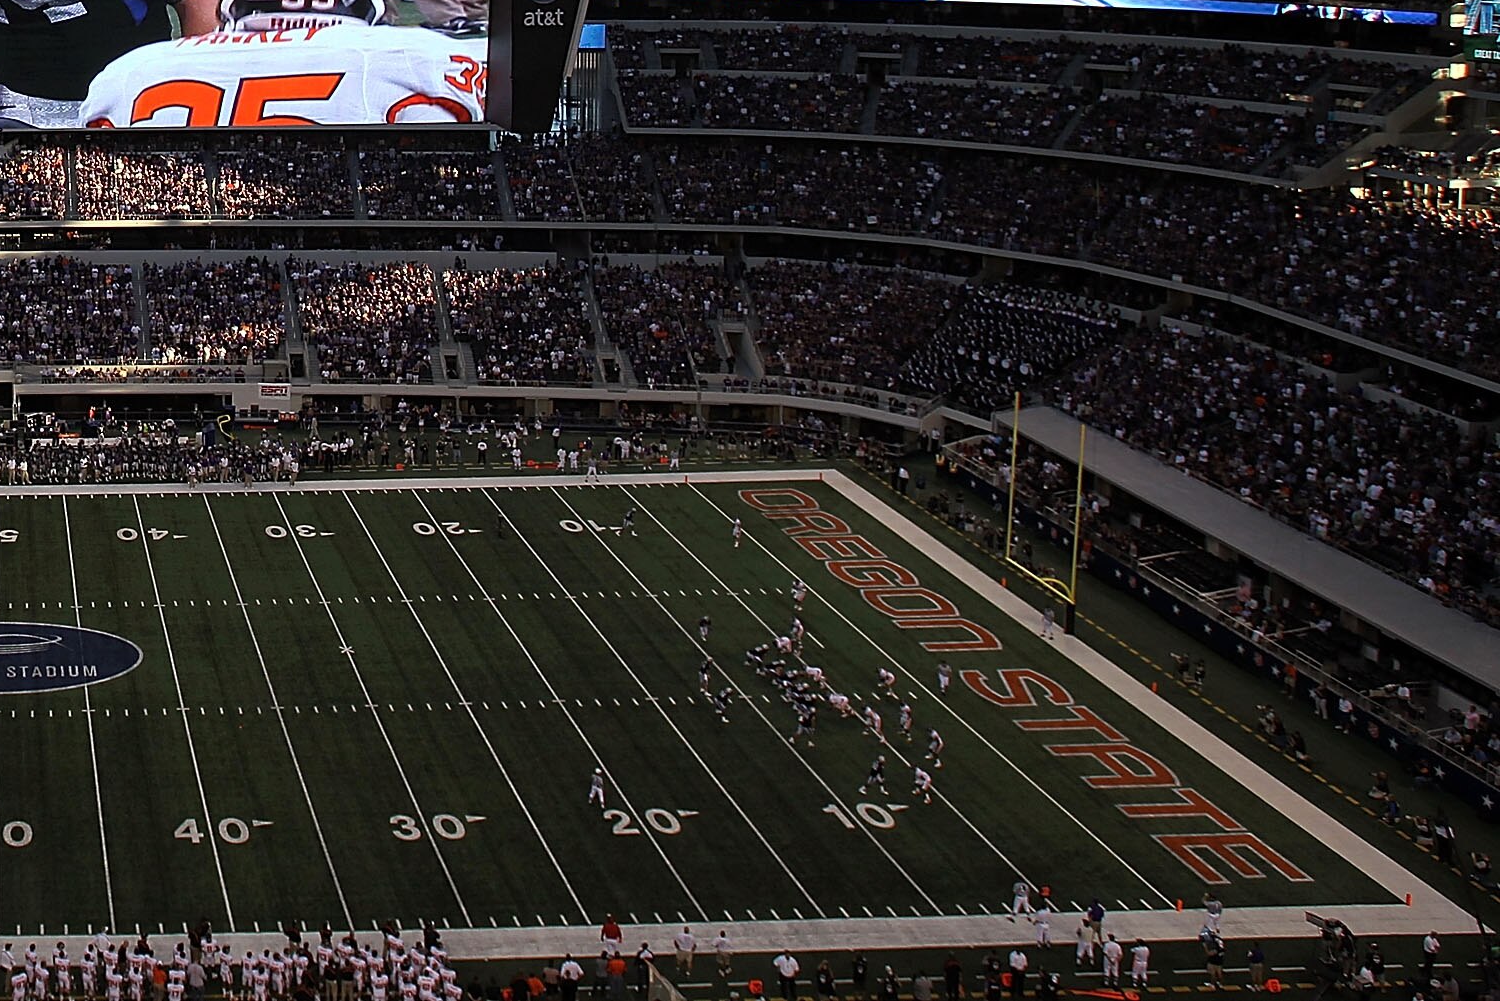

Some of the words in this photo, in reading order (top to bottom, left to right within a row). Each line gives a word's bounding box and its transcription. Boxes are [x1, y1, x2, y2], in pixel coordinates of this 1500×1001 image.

[524, 8, 565, 27] at&t
[117, 527, 170, 542] 40
[265, 524, 319, 539] 30
[412, 521, 466, 536] 20
[560, 518, 610, 534] 10
[6, 665, 97, 678] STADIUM
[738, 488, 1002, 652] OREGON
[959, 668, 1315, 885] STATE
[604, 808, 682, 835] 20
[822, 802, 896, 828] 10
[174, 817, 250, 844] 40
[390, 814, 466, 841] 30
